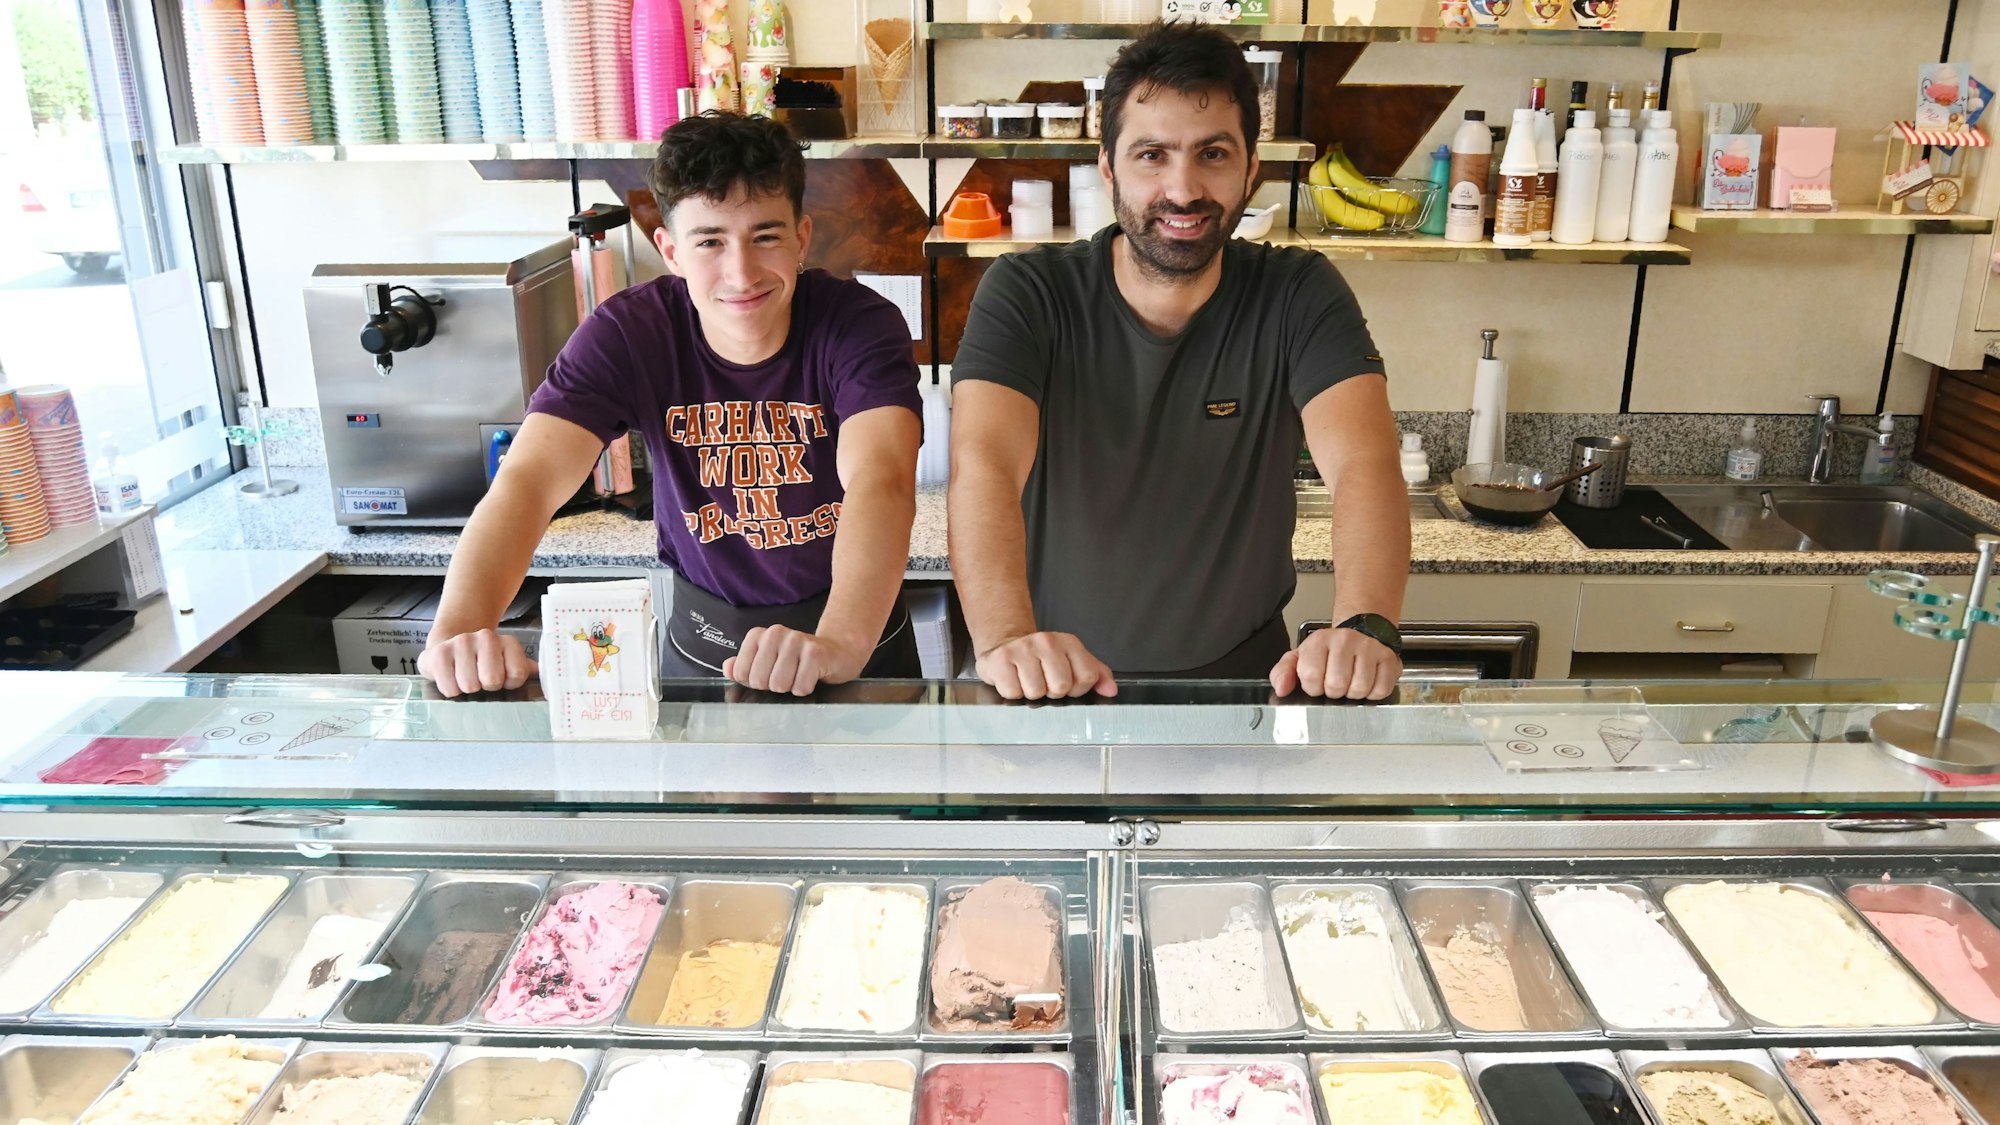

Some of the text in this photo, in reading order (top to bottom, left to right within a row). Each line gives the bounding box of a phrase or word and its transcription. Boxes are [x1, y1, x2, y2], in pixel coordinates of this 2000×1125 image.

[666, 400, 828, 447] CARHARTT
[698, 444, 813, 487] WORK
[732, 487, 781, 520] IN
